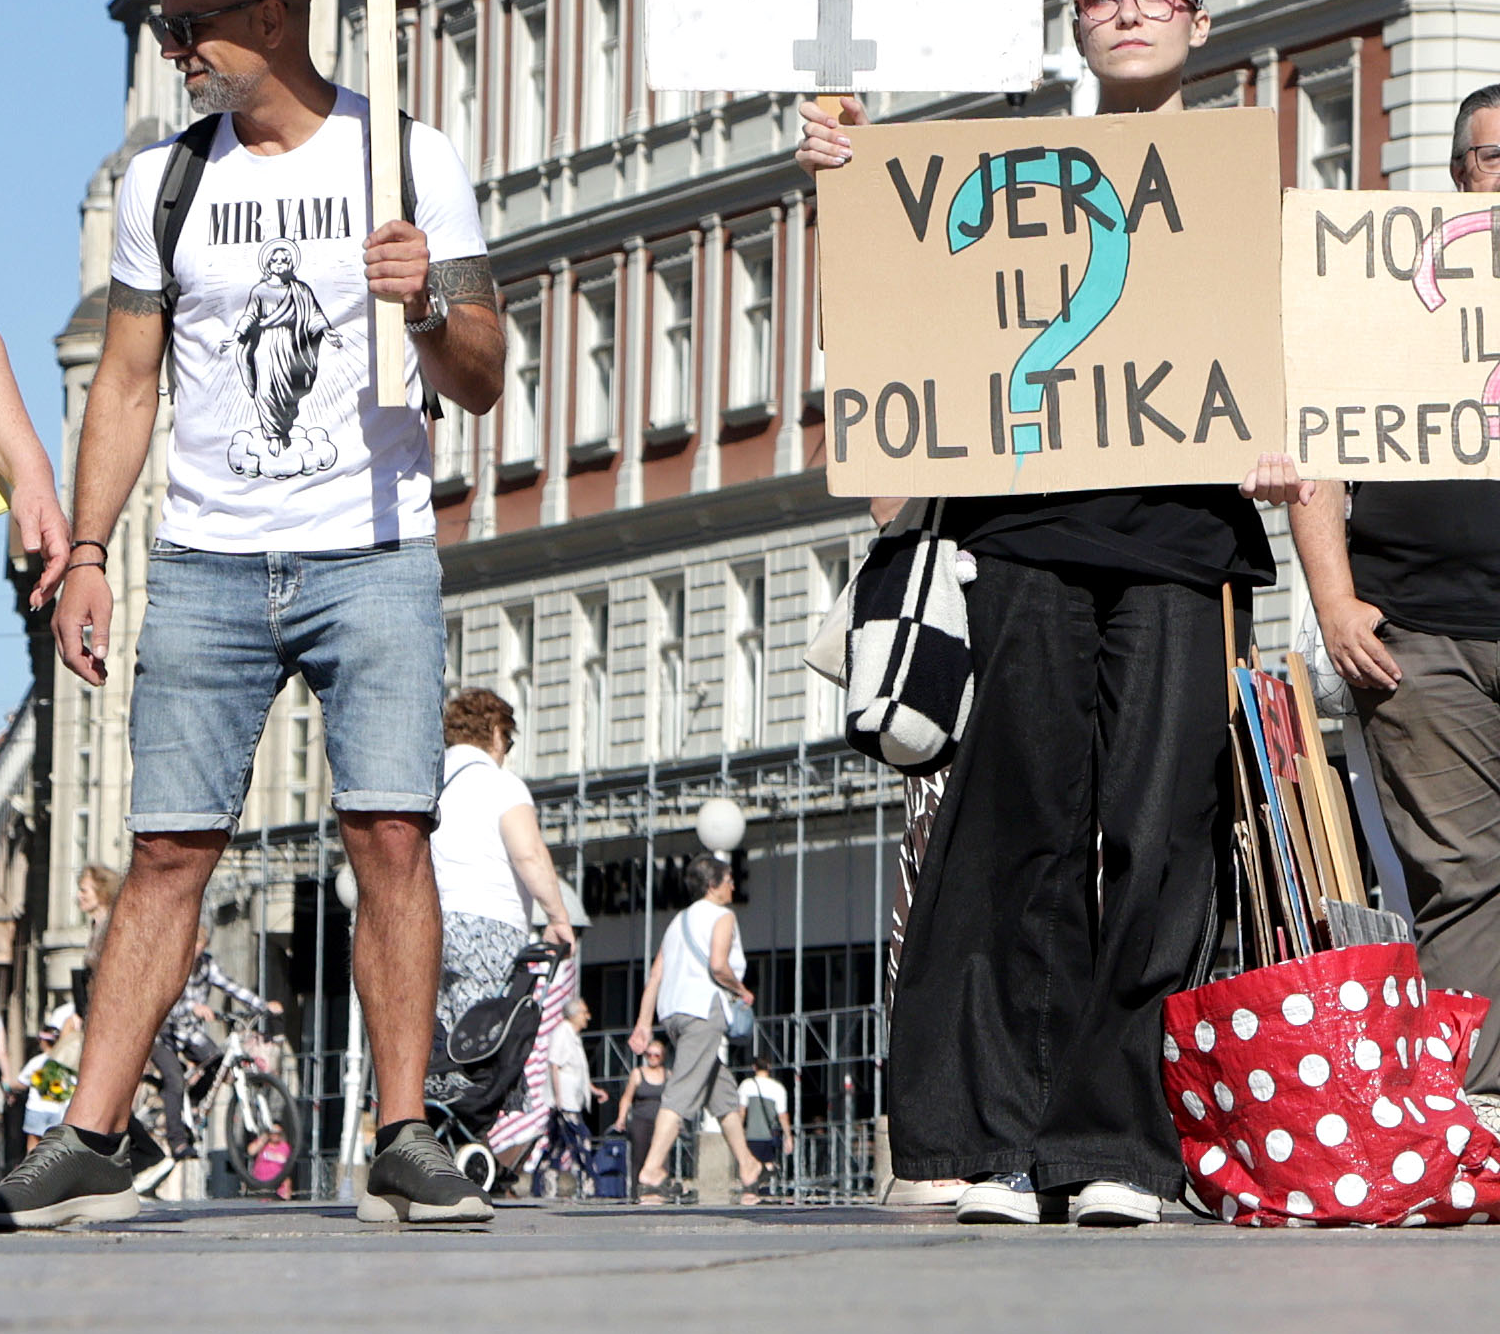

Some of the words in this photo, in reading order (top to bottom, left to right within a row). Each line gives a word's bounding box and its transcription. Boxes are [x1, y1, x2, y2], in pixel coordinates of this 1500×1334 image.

[208, 200, 265, 246] MIR
[276, 196, 351, 242] VAMA
[885, 142, 1184, 243] VJERA
[996, 264, 1071, 329] ILI
[833, 358, 1252, 463] POLITIKA
